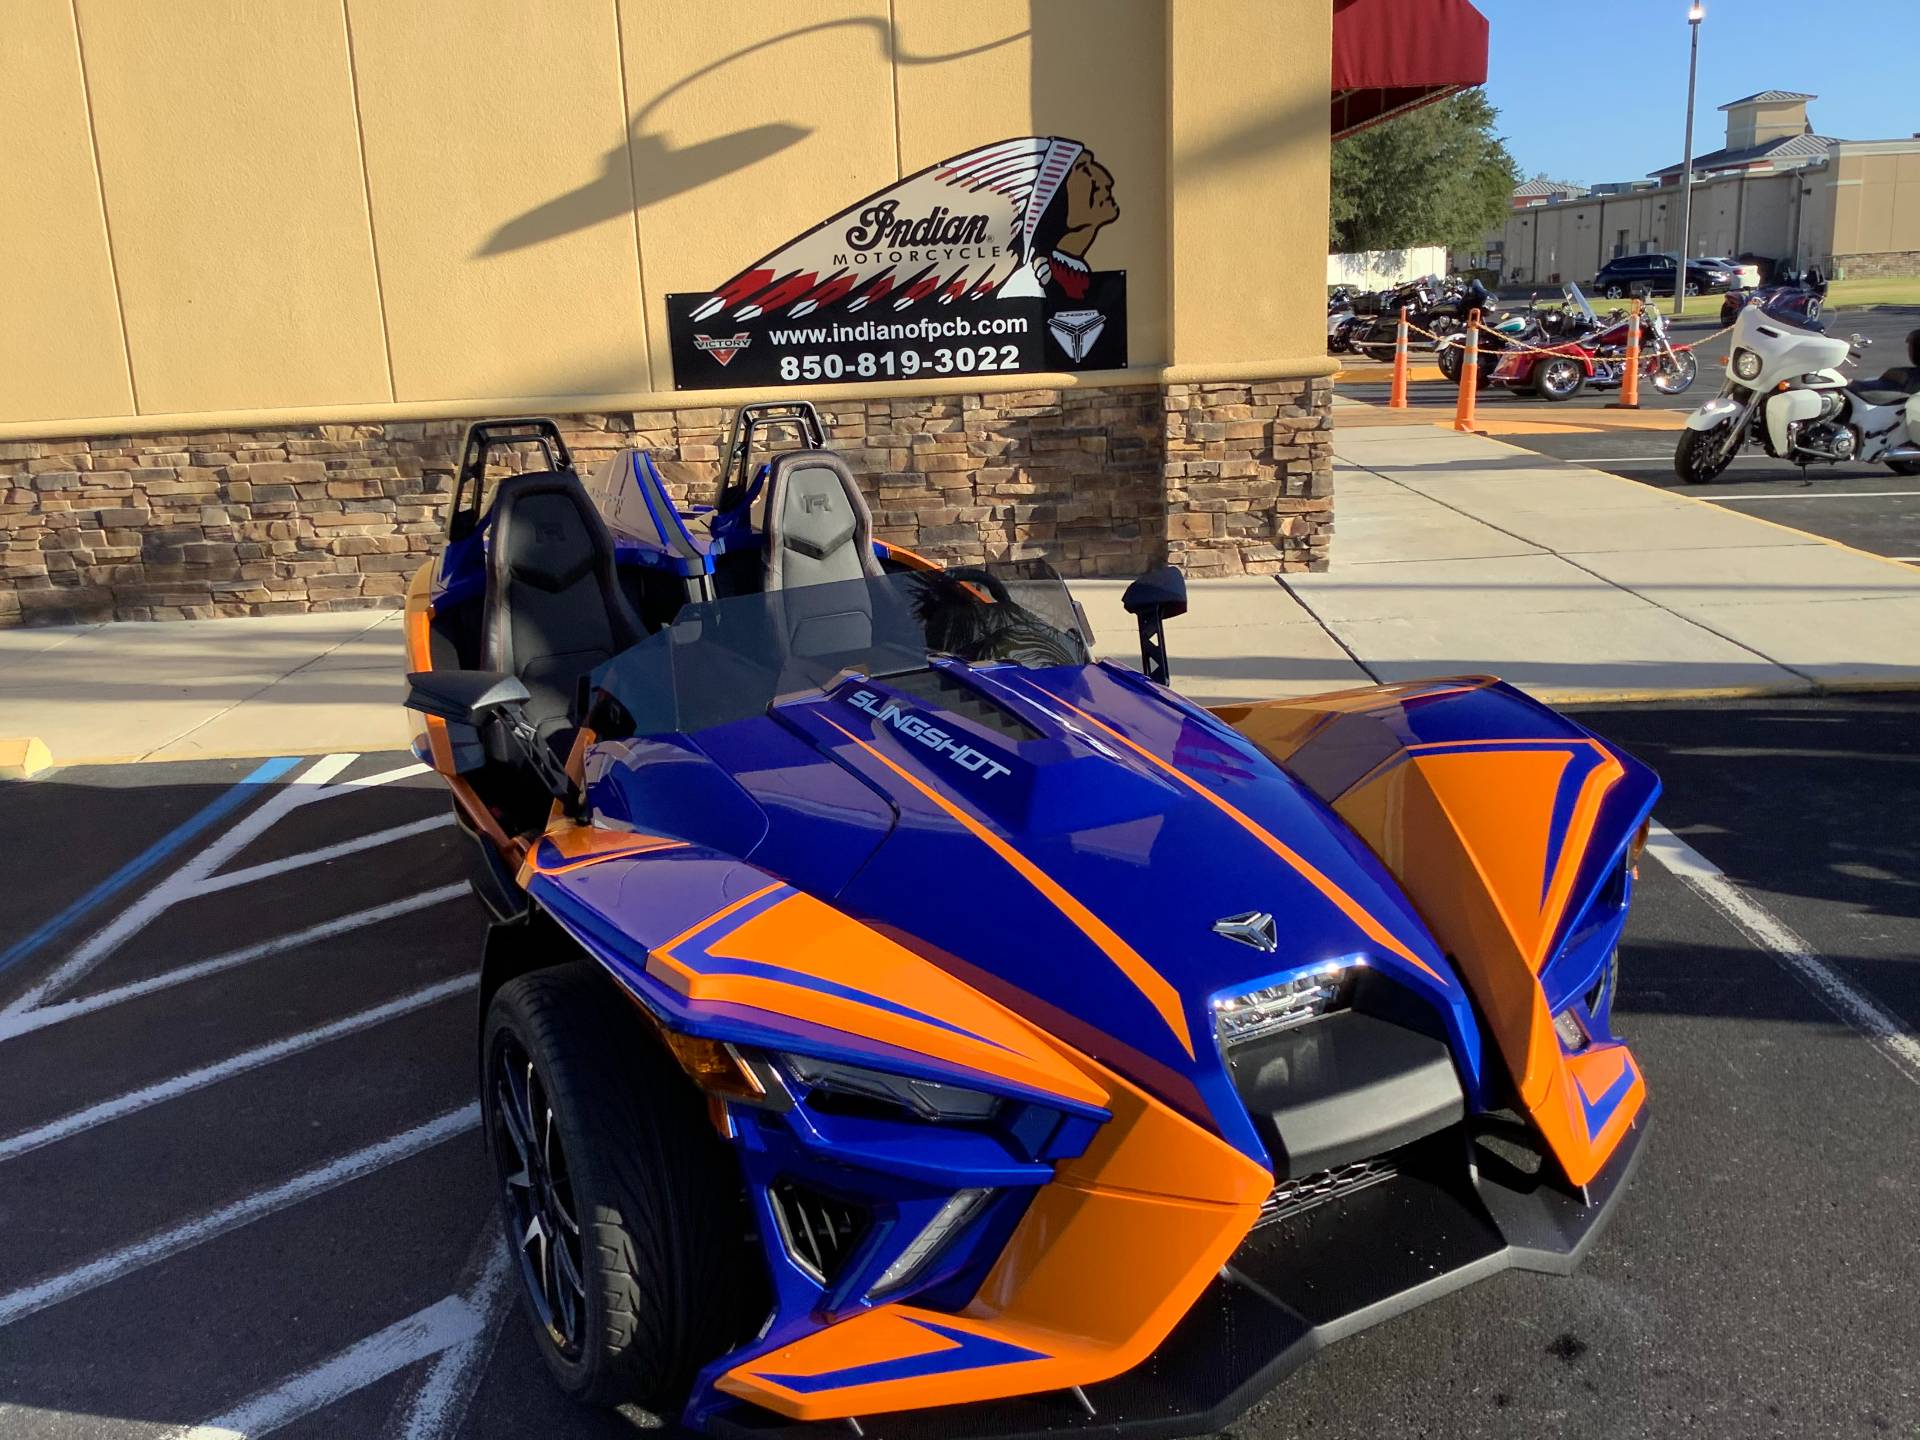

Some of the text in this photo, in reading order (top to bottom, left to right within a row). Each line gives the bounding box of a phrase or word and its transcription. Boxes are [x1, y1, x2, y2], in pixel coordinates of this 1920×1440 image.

[846, 199, 990, 251] Indian
[832, 246, 1001, 266] MOTORCYCLE
[696, 340, 749, 348] VICTORY
[768, 316, 1028, 346] www.indianofpcb.com
[780, 345, 1020, 380] 850-819-3022
[847, 690, 1012, 780] SLINGSHOT
